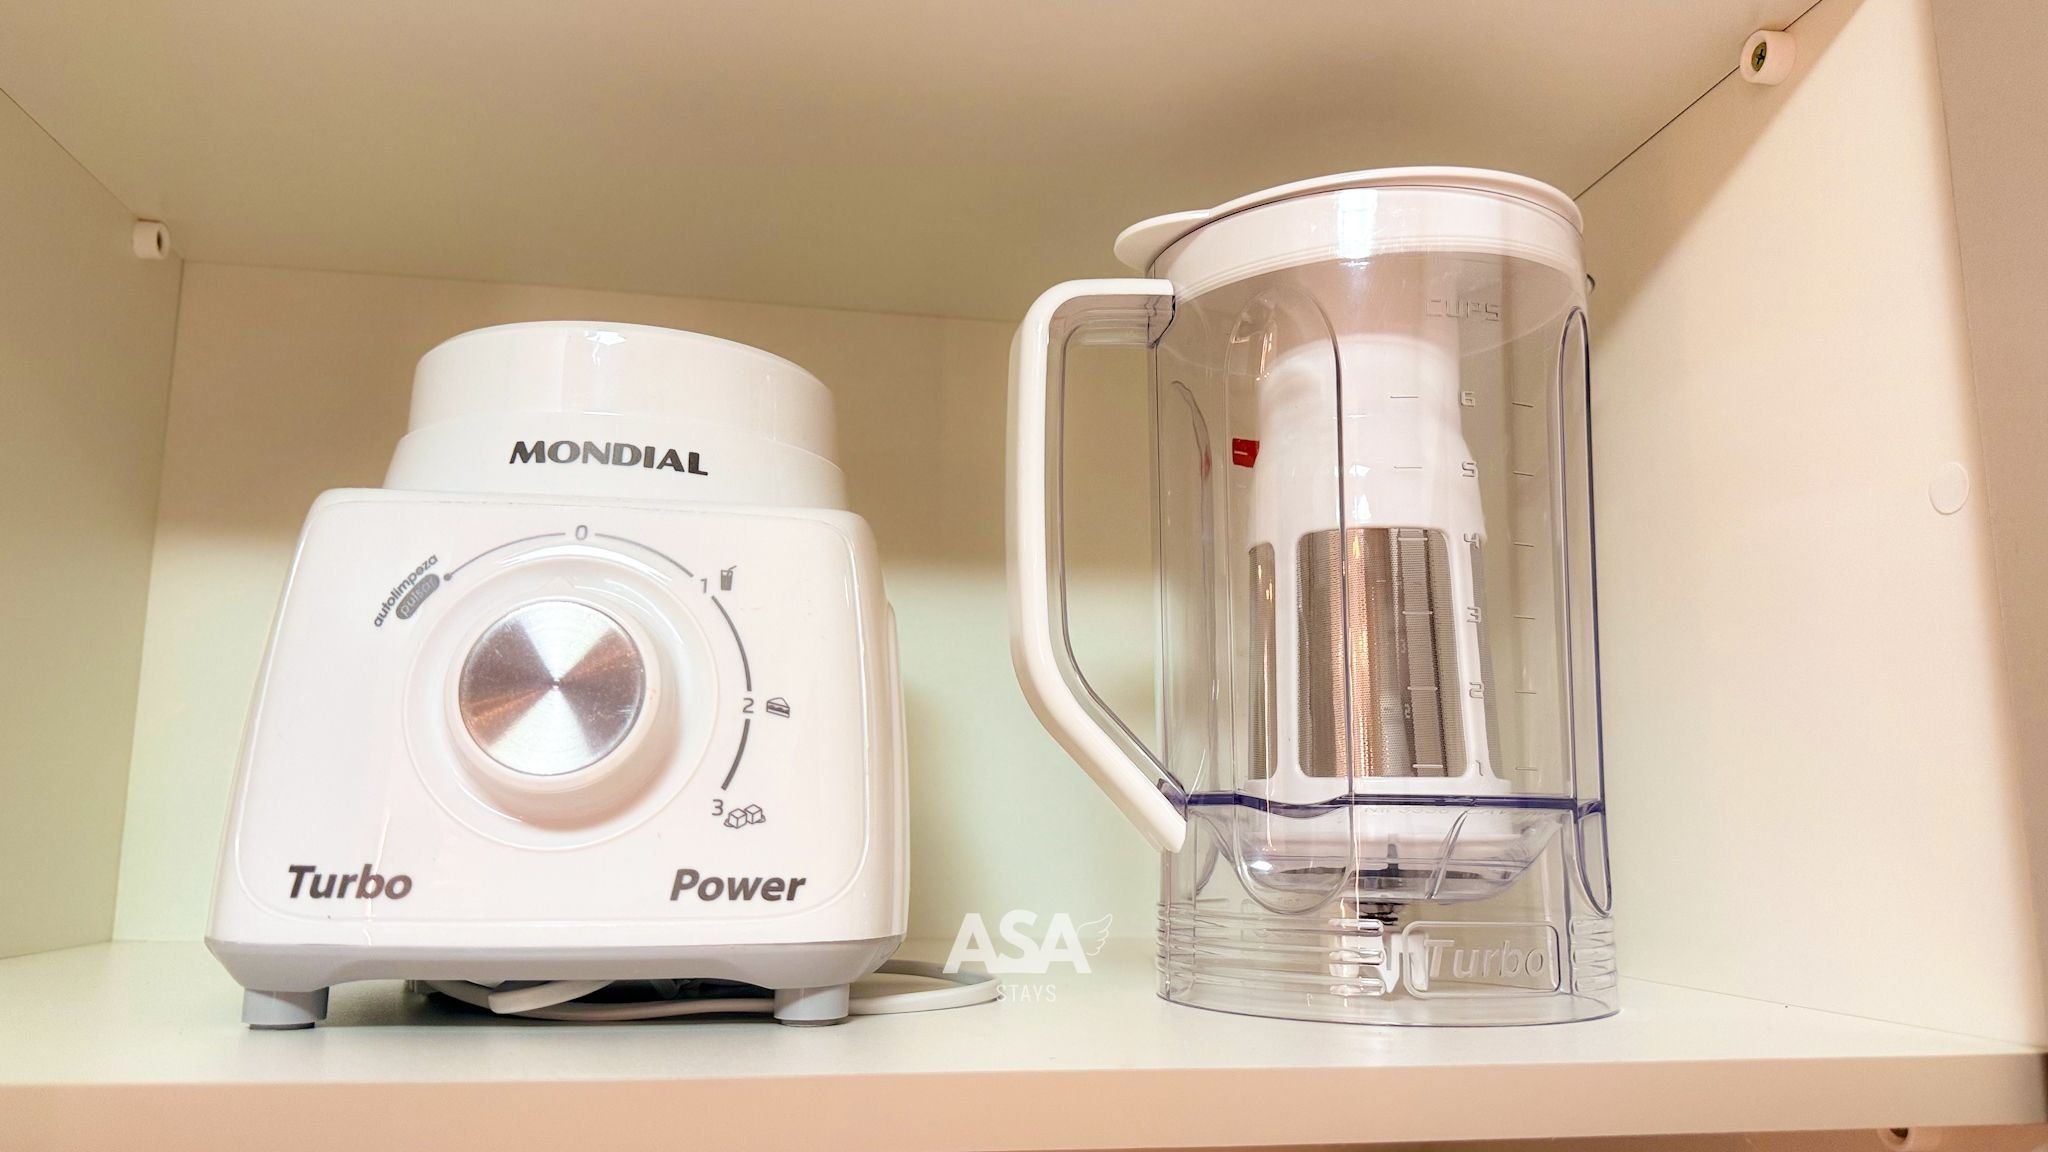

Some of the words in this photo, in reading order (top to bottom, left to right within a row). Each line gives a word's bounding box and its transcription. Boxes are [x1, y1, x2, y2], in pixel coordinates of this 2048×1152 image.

[1426, 298, 1500, 322] CUPS
[1460, 391, 1477, 408] 6
[509, 440, 709, 476] MONDIAL
[1461, 461, 1477, 478] 5
[574, 525, 589, 541] 0
[374, 554, 438, 627] autolimpeza
[700, 578, 708, 594] 1
[1467, 606, 1482, 624] 3
[1469, 681, 1485, 699] 2
[742, 697, 755, 714] 2
[711, 799, 724, 816] 3
[288, 863, 413, 900] Turbo
[670, 867, 807, 902] Power
[1423, 939, 1545, 978] Turbo
